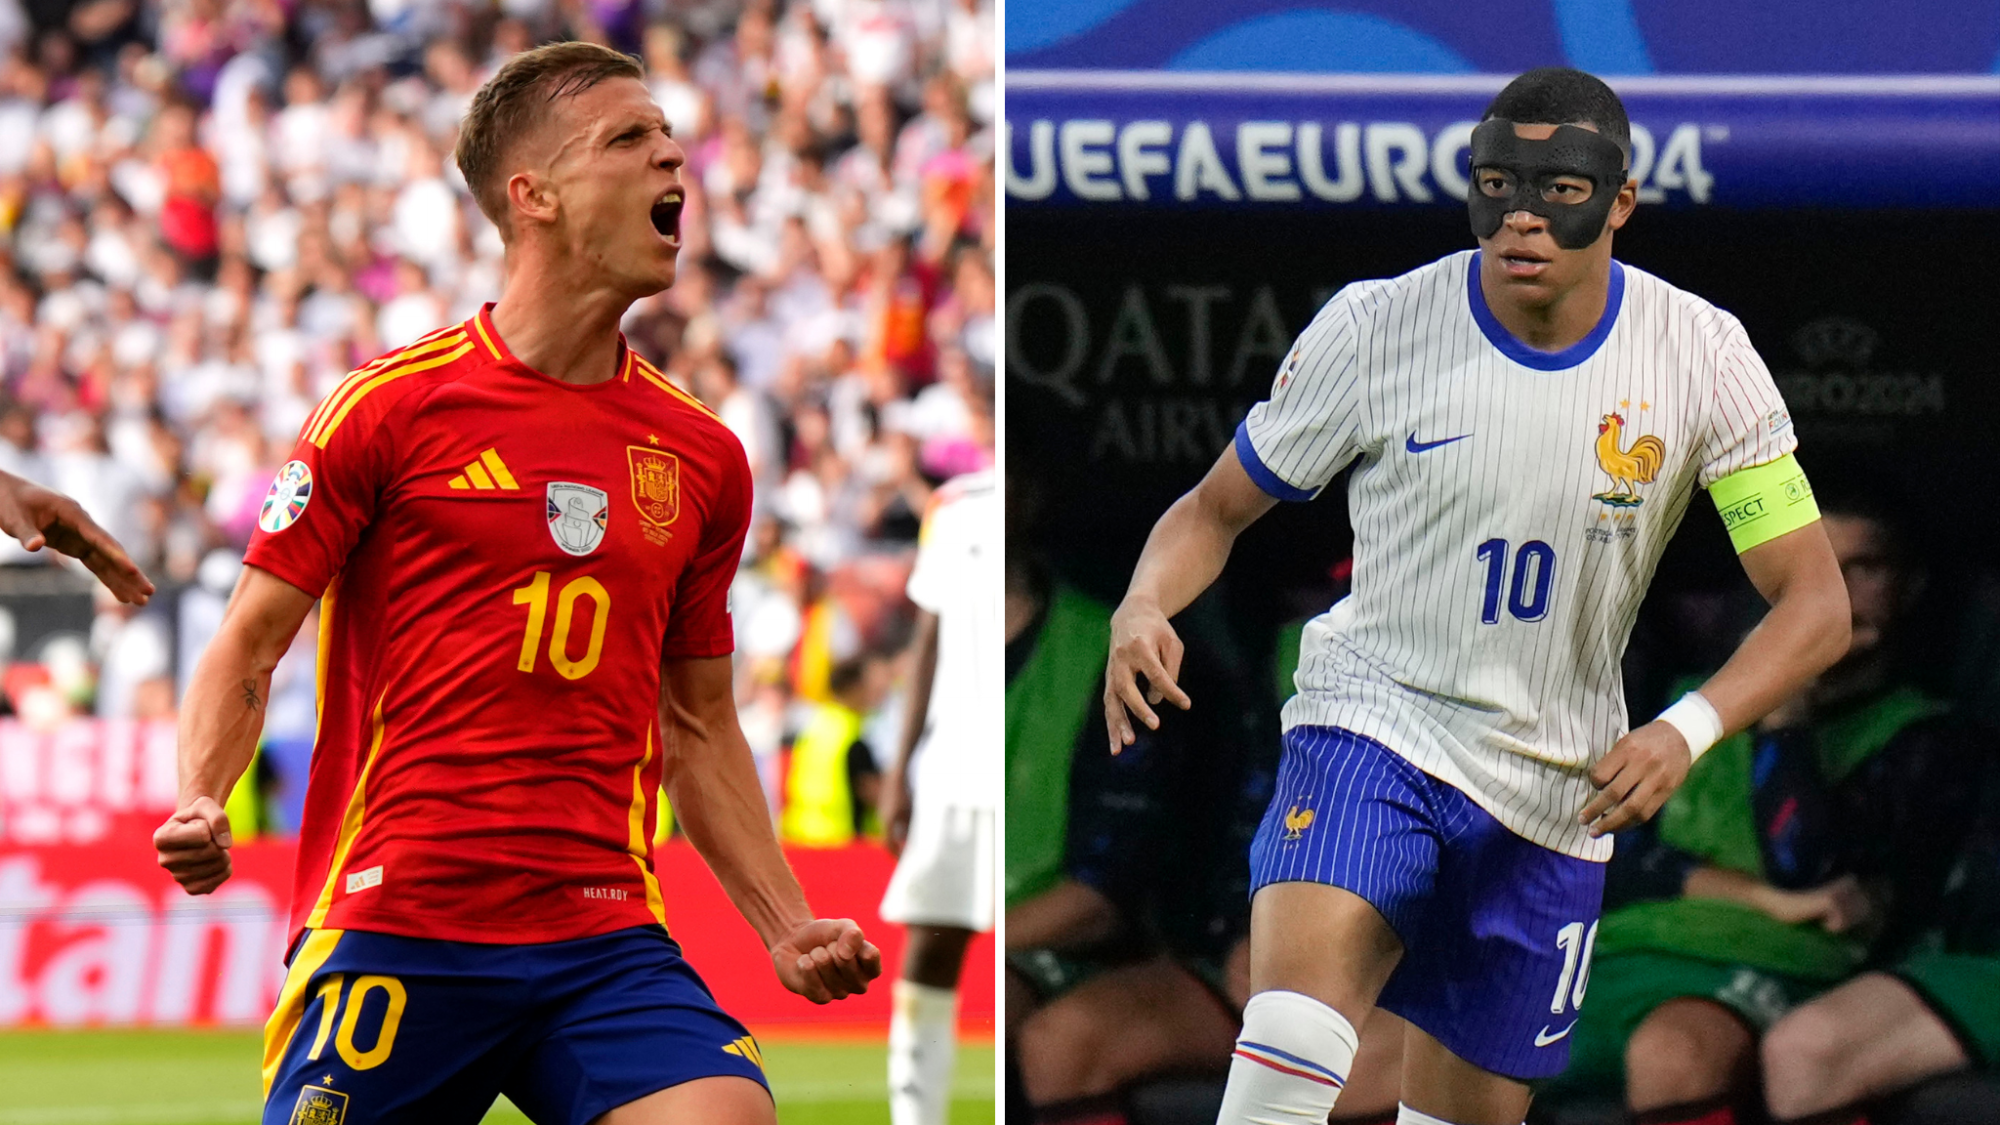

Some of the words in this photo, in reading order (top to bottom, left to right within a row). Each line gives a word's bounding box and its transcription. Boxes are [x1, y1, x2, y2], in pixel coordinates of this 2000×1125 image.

[1005, 281, 1338, 406] QATA
[1722, 497, 1764, 526] SPECT
[513, 571, 611, 680] 10
[1477, 538, 1557, 624] 10
[583, 887, 628, 901] HEAT.RDY
[307, 973, 407, 1071] 10
